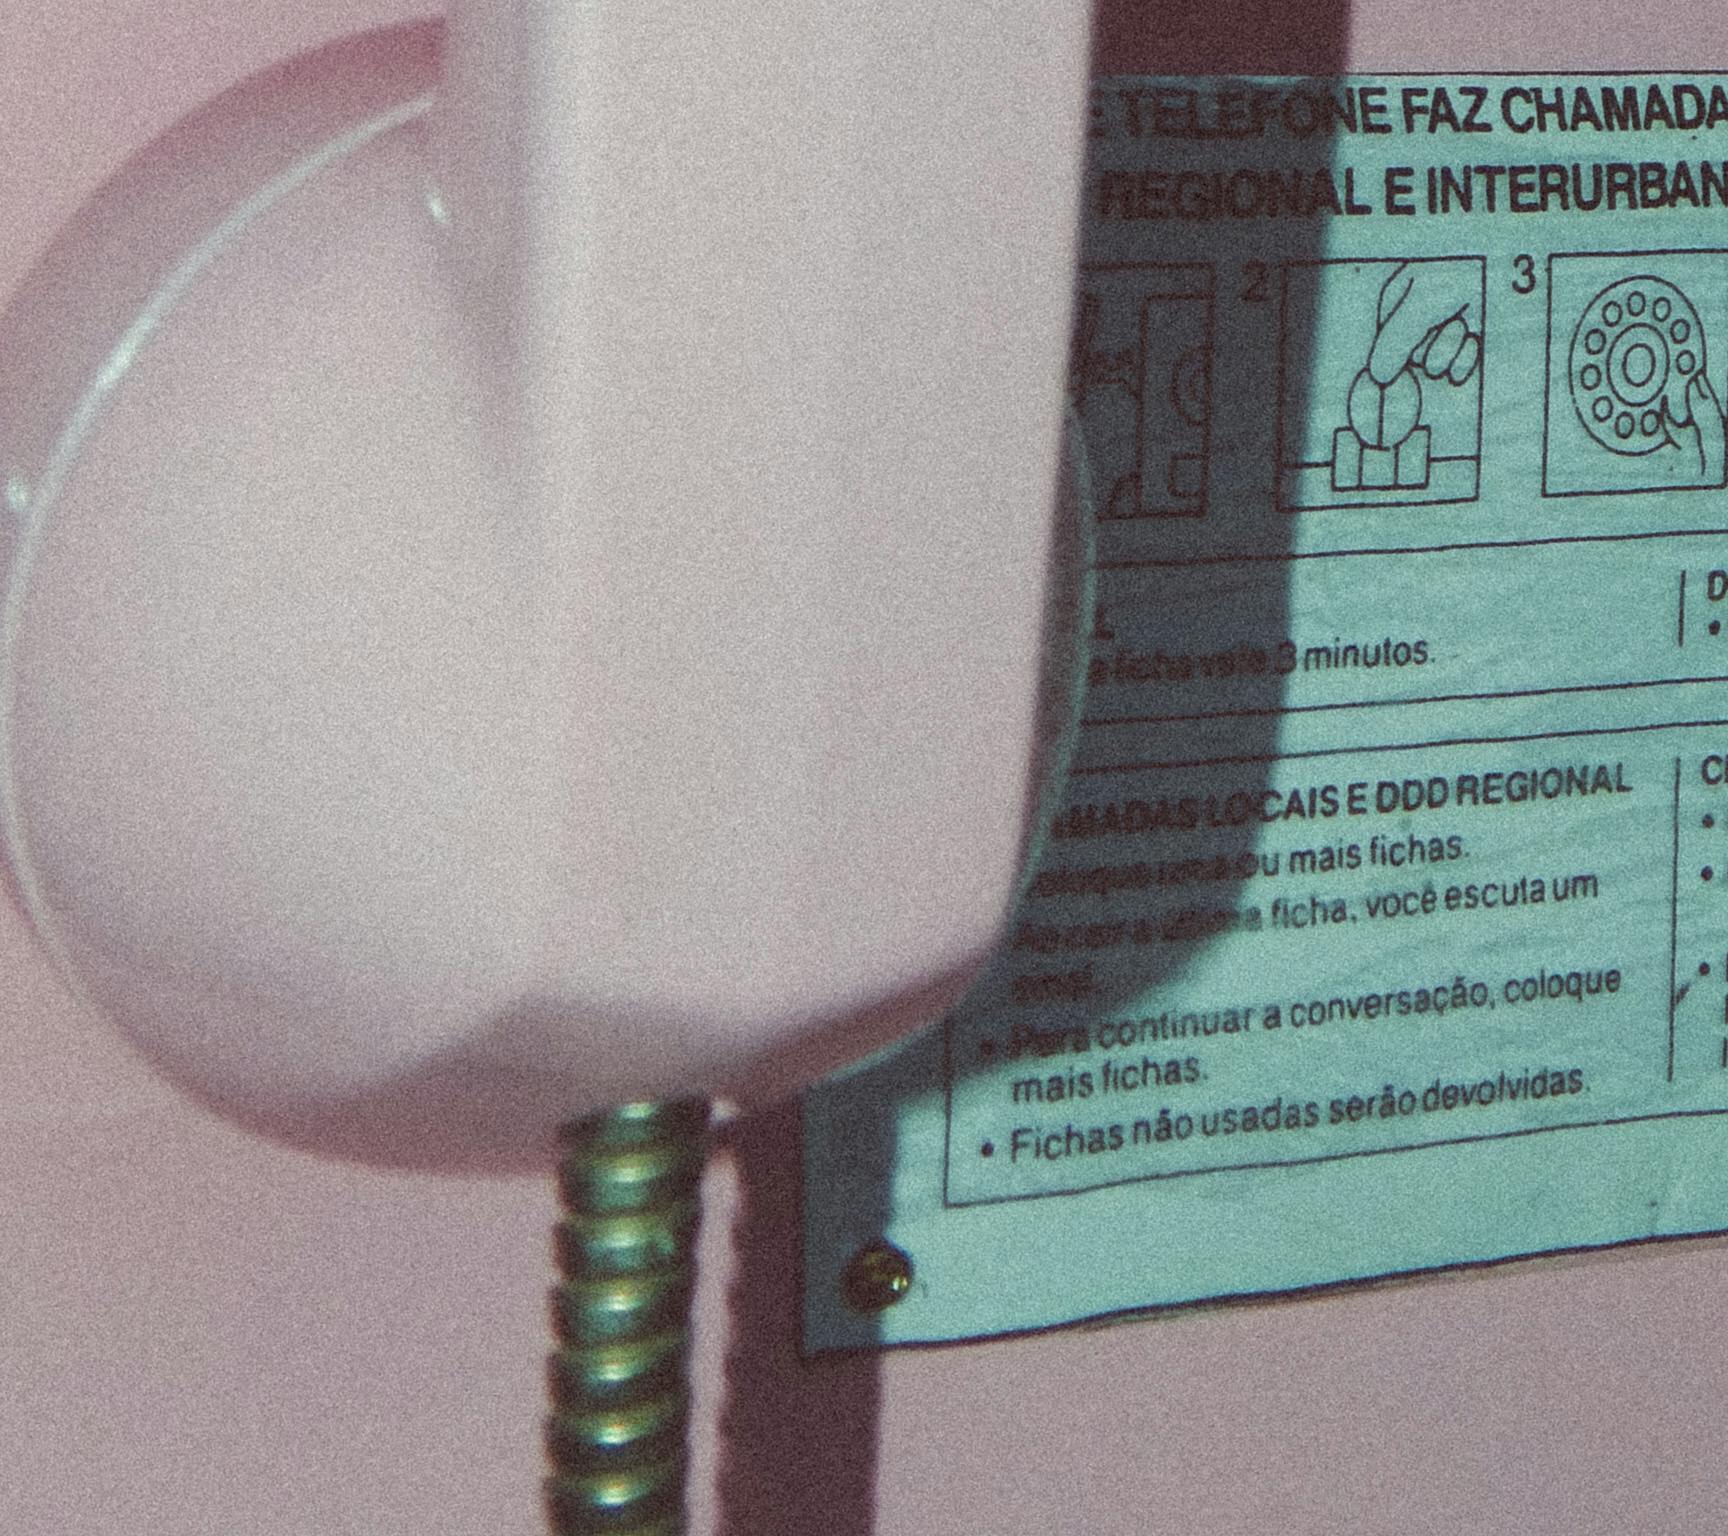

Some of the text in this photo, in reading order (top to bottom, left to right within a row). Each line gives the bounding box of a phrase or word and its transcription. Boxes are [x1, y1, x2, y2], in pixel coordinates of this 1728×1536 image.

[1118, 84, 1391, 138] TELEFONE
[1402, 85, 1490, 134] FAZ
[1098, 165, 1372, 222] REGIONAL
[1384, 167, 1415, 215] E
[1511, 254, 1536, 294] 3
[1278, 639, 1298, 675] 3
[1304, 636, 1436, 672] minutos.
[1206, 785, 1339, 828] LOCAIS
[1346, 782, 1368, 815] E
[1375, 776, 1449, 814] DDD
[1456, 762, 1634, 807] REGIONAL
[1289, 838, 1362, 874] mais
[1369, 833, 1470, 867] fichas.
[1271, 898, 1357, 928] ficha,
[1366, 881, 1438, 919] você
[1444, 873, 1546, 911] escuta
[1553, 871, 1599, 900] um
[1097, 1004, 1259, 1050] continuar
[1262, 1004, 1282, 1031] a
[1290, 975, 1496, 1029] conversação,
[1504, 967, 1623, 1007] coloque
[1011, 1054, 1209, 1105] mais fichas.
[1011, 1064, 1592, 1164] Fichas não usadas serão devolvidas.
